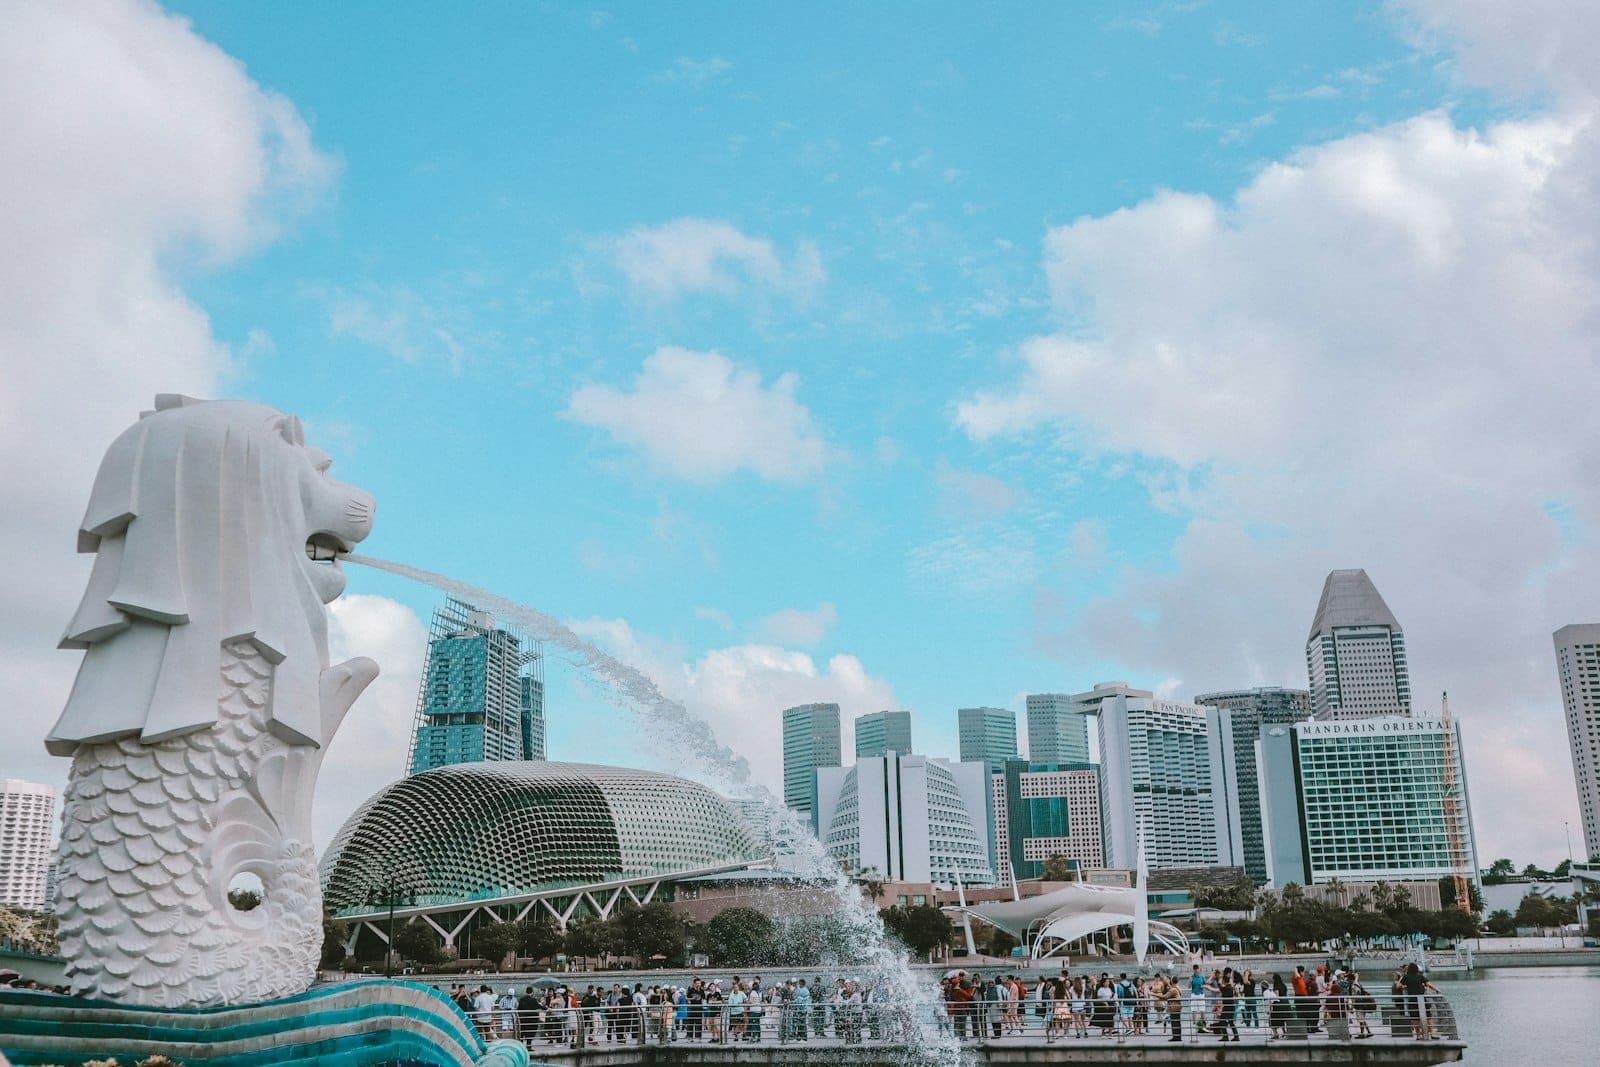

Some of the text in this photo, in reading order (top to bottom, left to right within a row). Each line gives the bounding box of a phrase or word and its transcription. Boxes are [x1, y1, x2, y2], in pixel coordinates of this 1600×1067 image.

[1160, 702, 1174, 712] PAN
[1228, 699, 1249, 709] SMBC
[1303, 722, 1376, 735] MANDARIN
